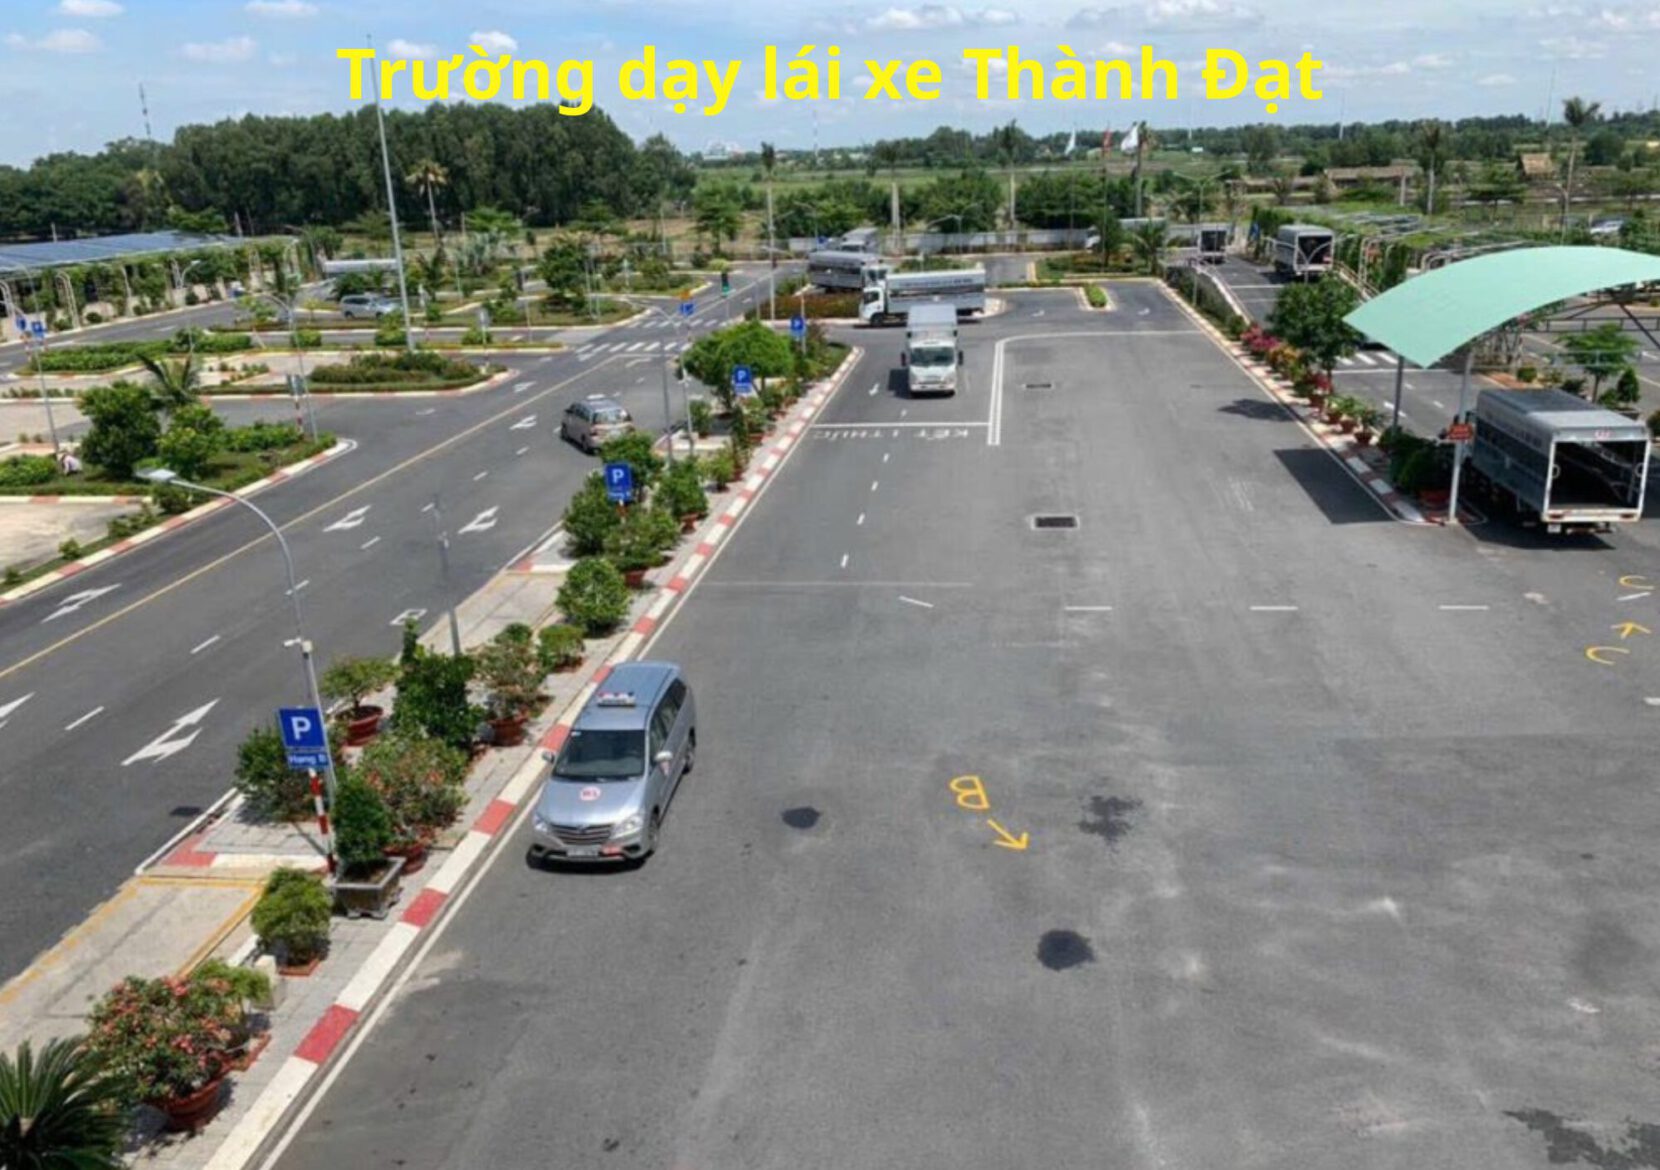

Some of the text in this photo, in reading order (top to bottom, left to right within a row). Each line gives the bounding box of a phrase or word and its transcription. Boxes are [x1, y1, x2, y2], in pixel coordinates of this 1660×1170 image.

[737, 369, 747, 381] P
[611, 468, 625, 484] P
[290, 715, 312, 740] P
[949, 774, 991, 811] B
